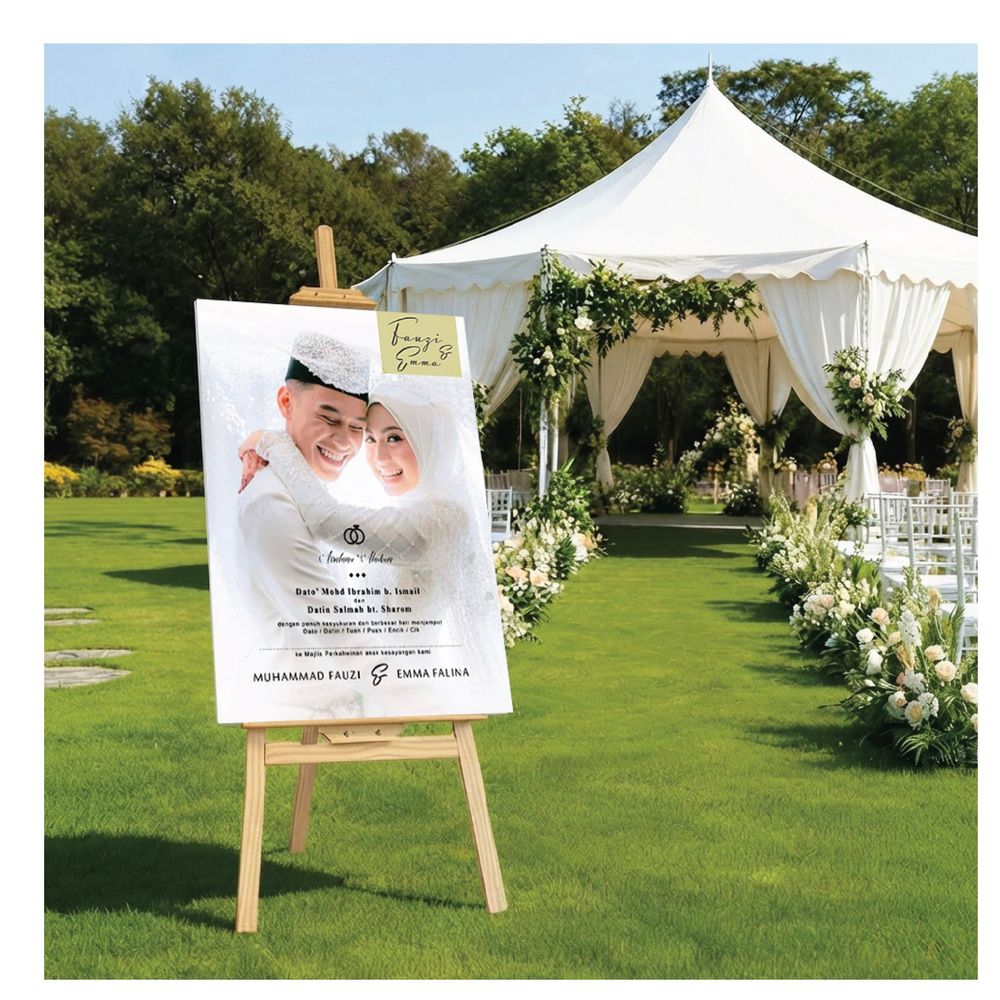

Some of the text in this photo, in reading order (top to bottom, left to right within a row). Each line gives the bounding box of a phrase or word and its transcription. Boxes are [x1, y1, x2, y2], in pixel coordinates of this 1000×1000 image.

[388, 316, 443, 353] Fauzi
[395, 345, 442, 372] Emma
[321, 588, 345, 596] Mohd
[348, 587, 381, 595] Ibrahim
[395, 587, 420, 595] Ismail
[308, 606, 331, 614] Datin
[333, 605, 364, 613] Salmah
[381, 605, 412, 613] Sharom
[253, 671, 324, 682] MUHAMMAD
[328, 670, 361, 681] FAUZI
[397, 669, 429, 679] EMMA
[432, 667, 470, 678] FALINA
